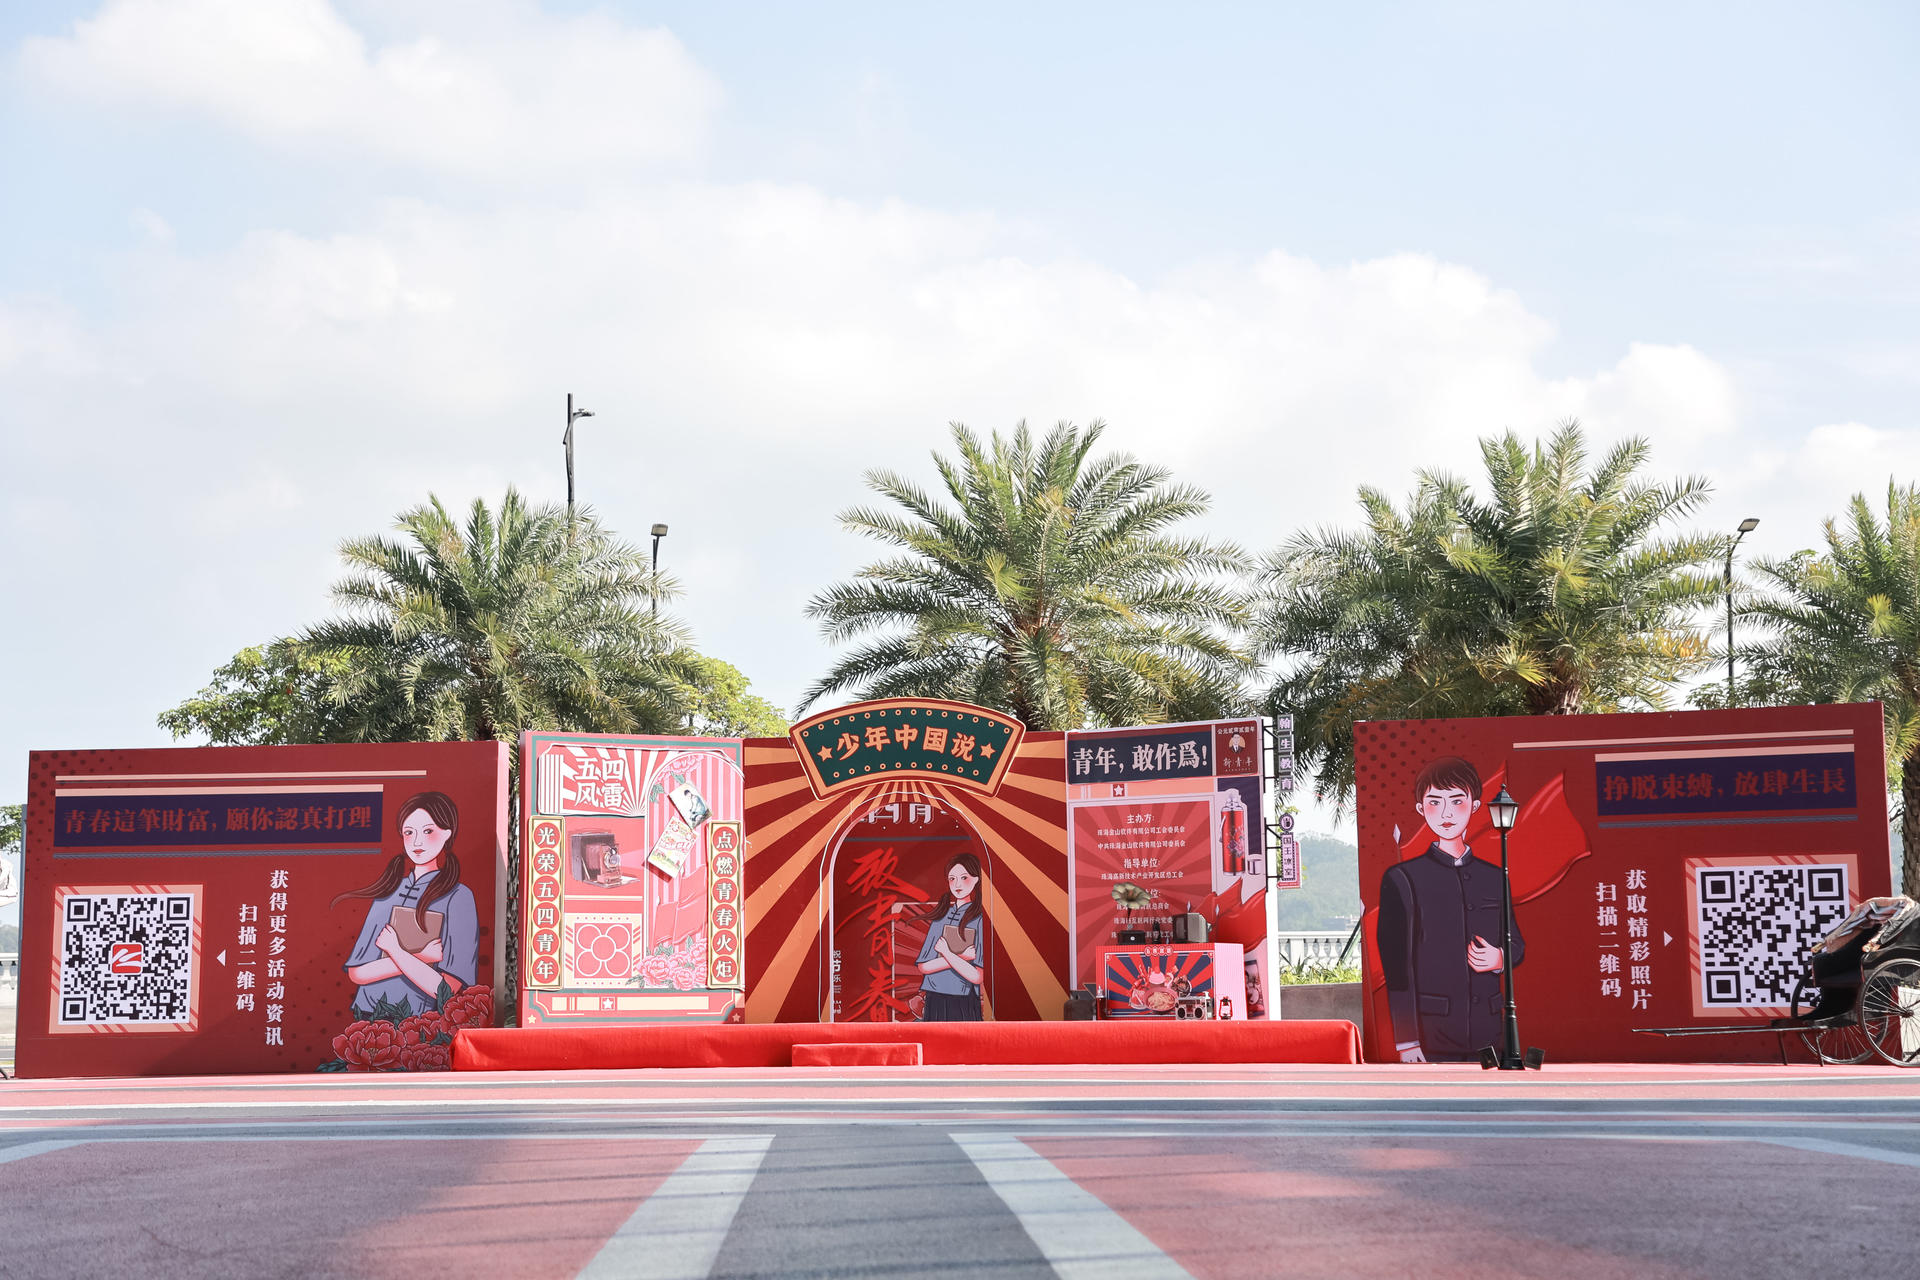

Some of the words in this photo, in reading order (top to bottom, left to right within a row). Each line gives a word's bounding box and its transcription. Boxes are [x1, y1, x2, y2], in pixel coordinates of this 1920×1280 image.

[575, 757, 625, 781] 五四
[575, 782, 625, 808] 风雷
[835, 723, 977, 763] 少年中国说
[236, 904, 258, 1012] 扫描二维码
[265, 869, 289, 1046] 获得更多活动资讯
[536, 826, 558, 980] 光荣五四青年
[715, 830, 734, 978] 点燃青春火炬
[1595, 882, 1622, 999] 扫描二维码
[1625, 869, 1653, 1010] 获取精彩照片
